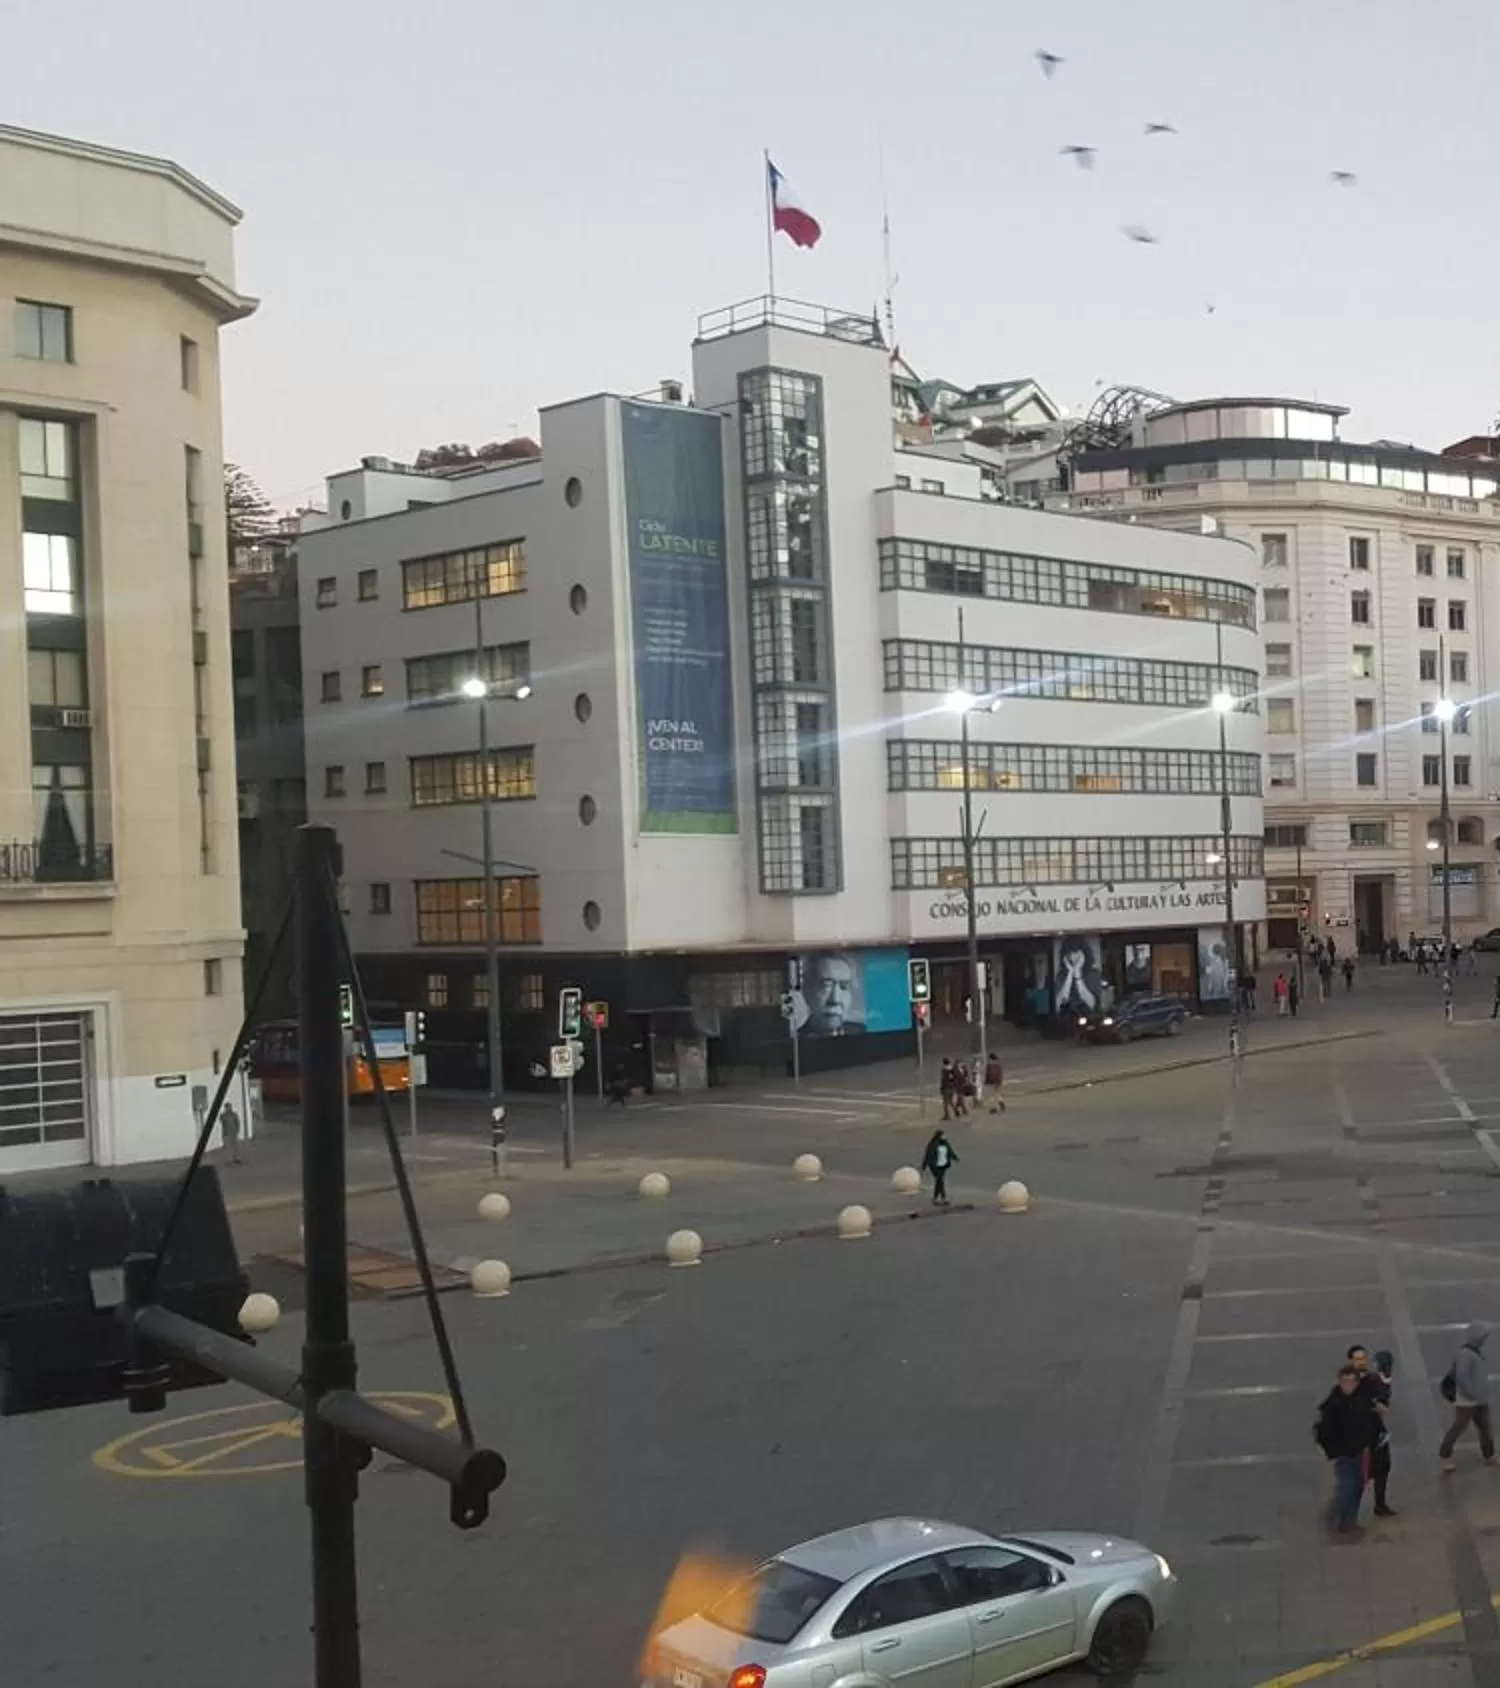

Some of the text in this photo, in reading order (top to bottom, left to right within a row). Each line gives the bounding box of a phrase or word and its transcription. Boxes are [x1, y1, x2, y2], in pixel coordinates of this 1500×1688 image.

[640, 532, 717, 557] LATENTE
[929, 901, 991, 919] CONSJO
[997, 899, 1060, 915] NACIONAL
[1064, 898, 1080, 912] DE
[1085, 896, 1102, 911] LA
[1107, 895, 1157, 911] CULTURA
[1157, 895, 1167, 909] Y
[1171, 893, 1190, 907] LAS
